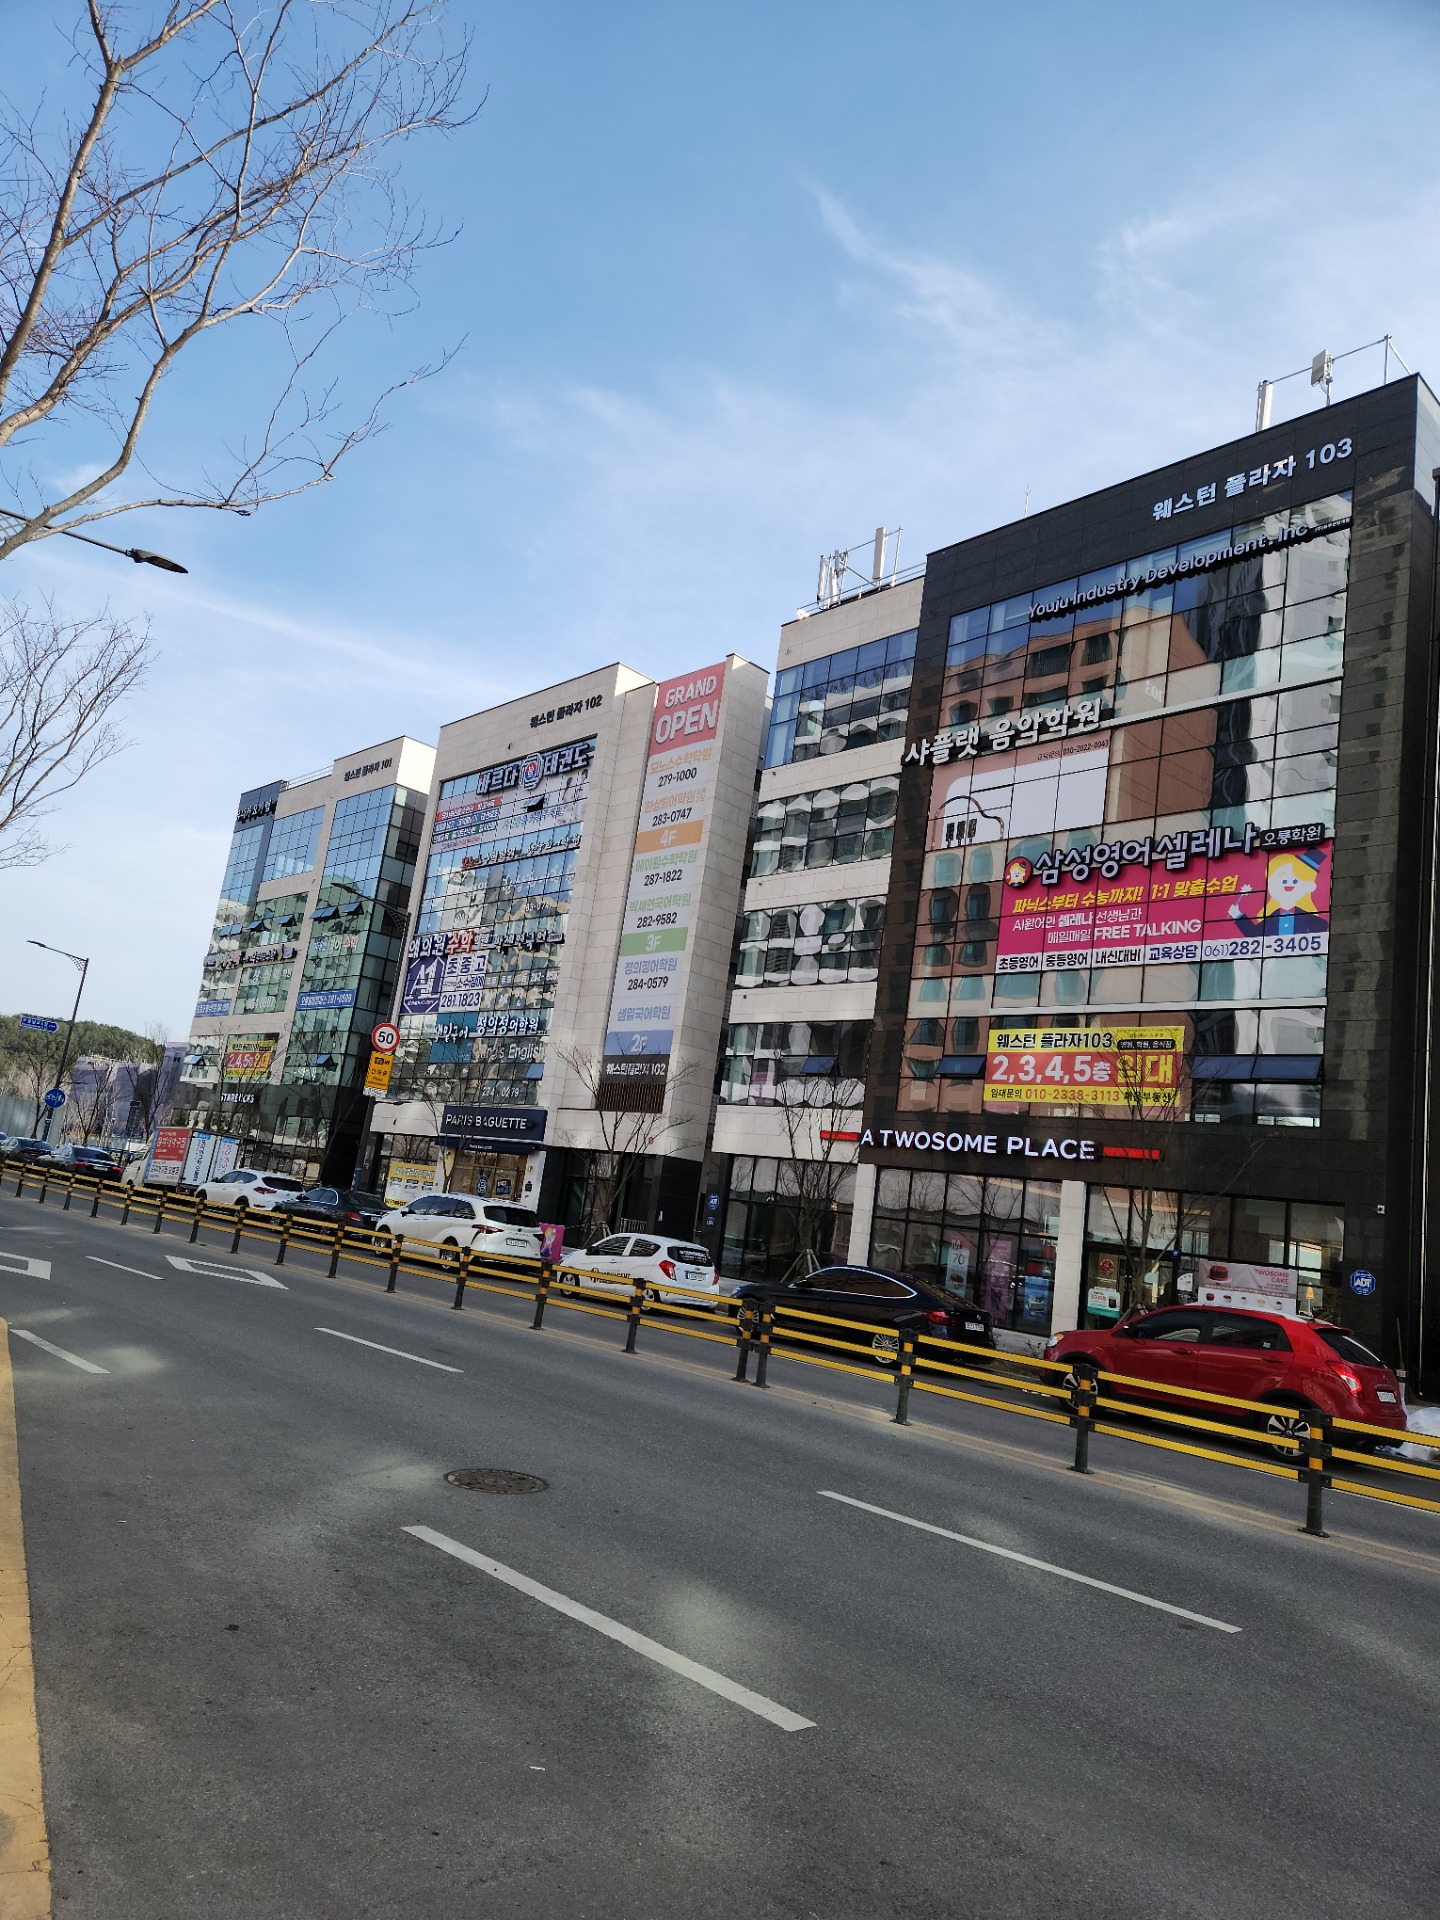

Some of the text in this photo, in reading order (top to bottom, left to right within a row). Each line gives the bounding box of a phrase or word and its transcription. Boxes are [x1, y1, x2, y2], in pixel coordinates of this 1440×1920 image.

[1152, 437, 1353, 521] 웨스턴 플라자 103
[1028, 596, 1071, 619] Youju
[1072, 574, 1145, 604] Industry
[1278, 522, 1309, 542] Inc
[664, 675, 717, 709] GRAND
[556, 700, 583, 720] 플라자
[584, 694, 603, 710] 102
[655, 699, 719, 744] OPEN
[905, 697, 1101, 766] 샤플랫 음악학원
[380, 757, 393, 770] 101
[477, 743, 591, 796] 바르다 태권도
[658, 767, 697, 788] 279-1000
[652, 807, 692, 827] 283-0747
[660, 829, 677, 847] 4F
[635, 850, 699, 872] 에이원수학학원
[1035, 824, 1322, 886] 삼성영어 셀레나 오룡학원
[644, 869, 683, 887] 287-1822
[1013, 875, 1239, 913] 파닉스부터 수능까지! 1:1 맞춤수업
[636, 912, 678, 929] 282-9582
[1013, 908, 1142, 932] AI원어민 셀레나 선생님과
[1047, 919, 1201, 944] 매일매일 FREE TALKING
[645, 934, 661, 951] 3F
[624, 957, 677, 975] 정의정어학원
[999, 955, 1039, 971] 초등영어
[1046, 952, 1088, 968] 중등영어
[1096, 948, 1141, 964] 내신대비
[1148, 944, 1197, 961] 교육상담
[627, 976, 669, 991] 284-0579
[477, 1014, 539, 1036] 정의정어학원
[377, 1031, 394, 1044] 50
[630, 1033, 648, 1052] 2F
[997, 1031, 1113, 1049] 웨스턴 플라자103
[650, 1063, 666, 1076] 102
[992, 1054, 1174, 1084] 2,3,4,5층 임대
[991, 1088, 1022, 1099] 임대문의
[1025, 1088, 1120, 1102] 010-2338-3113
[445, 1113, 528, 1130] PARIS BAGUETTE
[860, 1128, 1096, 1161] A TWOSOME PLACE
[1254, 1268, 1290, 1279] TWOSOME
[1271, 1277, 1290, 1286] CAKE
[1354, 1277, 1372, 1289] ADT
